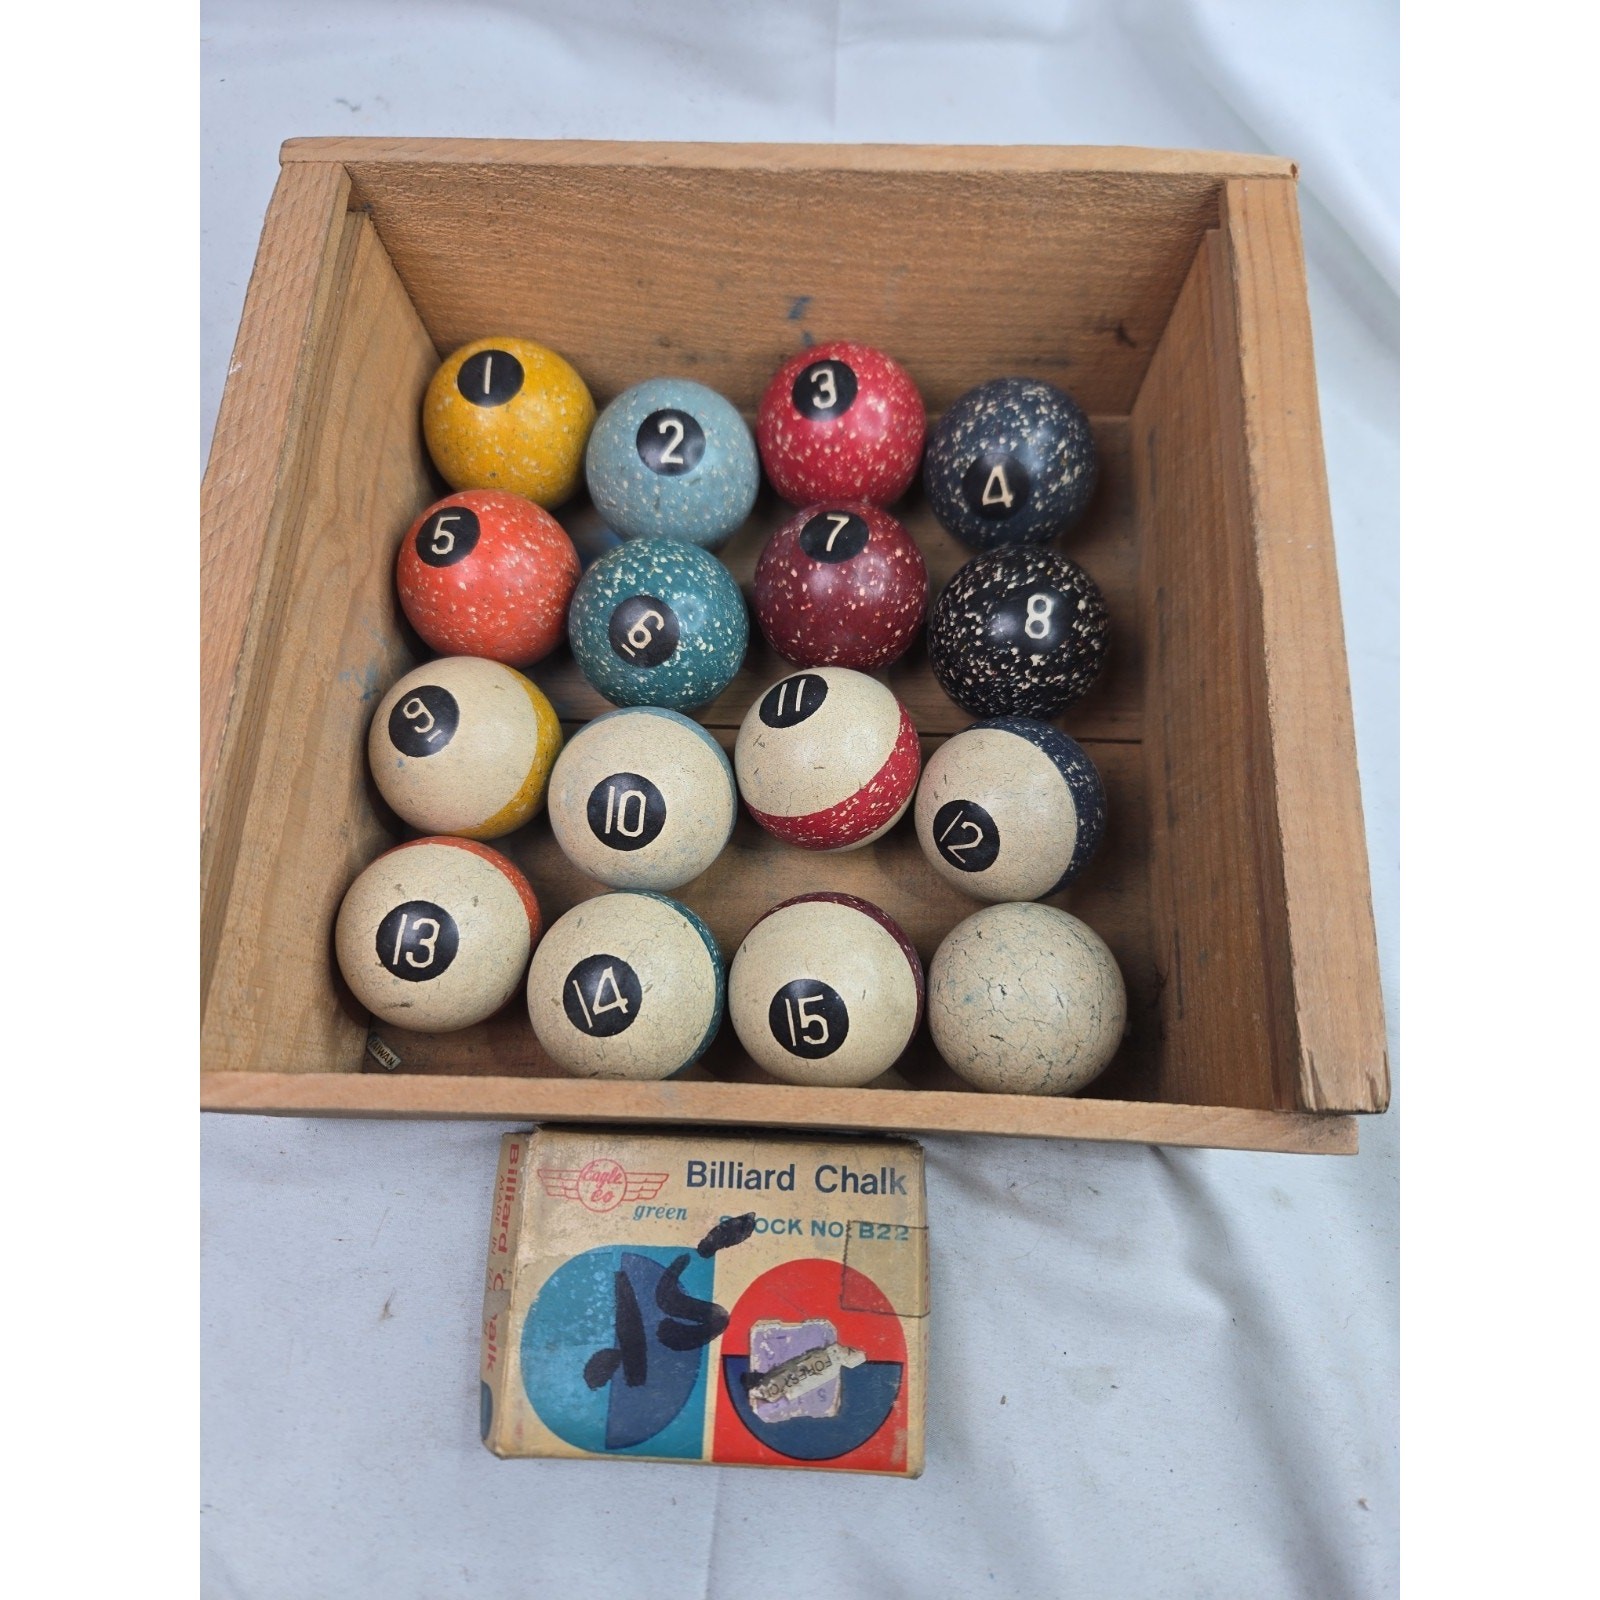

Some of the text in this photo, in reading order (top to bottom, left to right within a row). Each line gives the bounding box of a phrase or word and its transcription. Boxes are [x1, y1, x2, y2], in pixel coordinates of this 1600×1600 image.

[484, 356, 493, 395] 1
[810, 368, 838, 410] 3
[658, 419, 685, 465] 2
[981, 464, 1014, 508] 4
[431, 515, 461, 555] 5
[826, 513, 850, 553] 7
[1024, 592, 1053, 640] 8
[402, 697, 436, 734] 9
[776, 678, 805, 717] 11
[604, 785, 647, 838] 10
[939, 810, 984, 864] 12
[392, 913, 441, 969] 13
[572, 965, 629, 1029] 14
[784, 994, 830, 1047] 15
[580, 1159, 623, 1189] Eagle
[686, 1159, 908, 1196] Billiard Chalk
[498, 1143, 520, 1254] Billiard
[633, 1203, 688, 1222] green
[858, 1221, 909, 1241] B22
